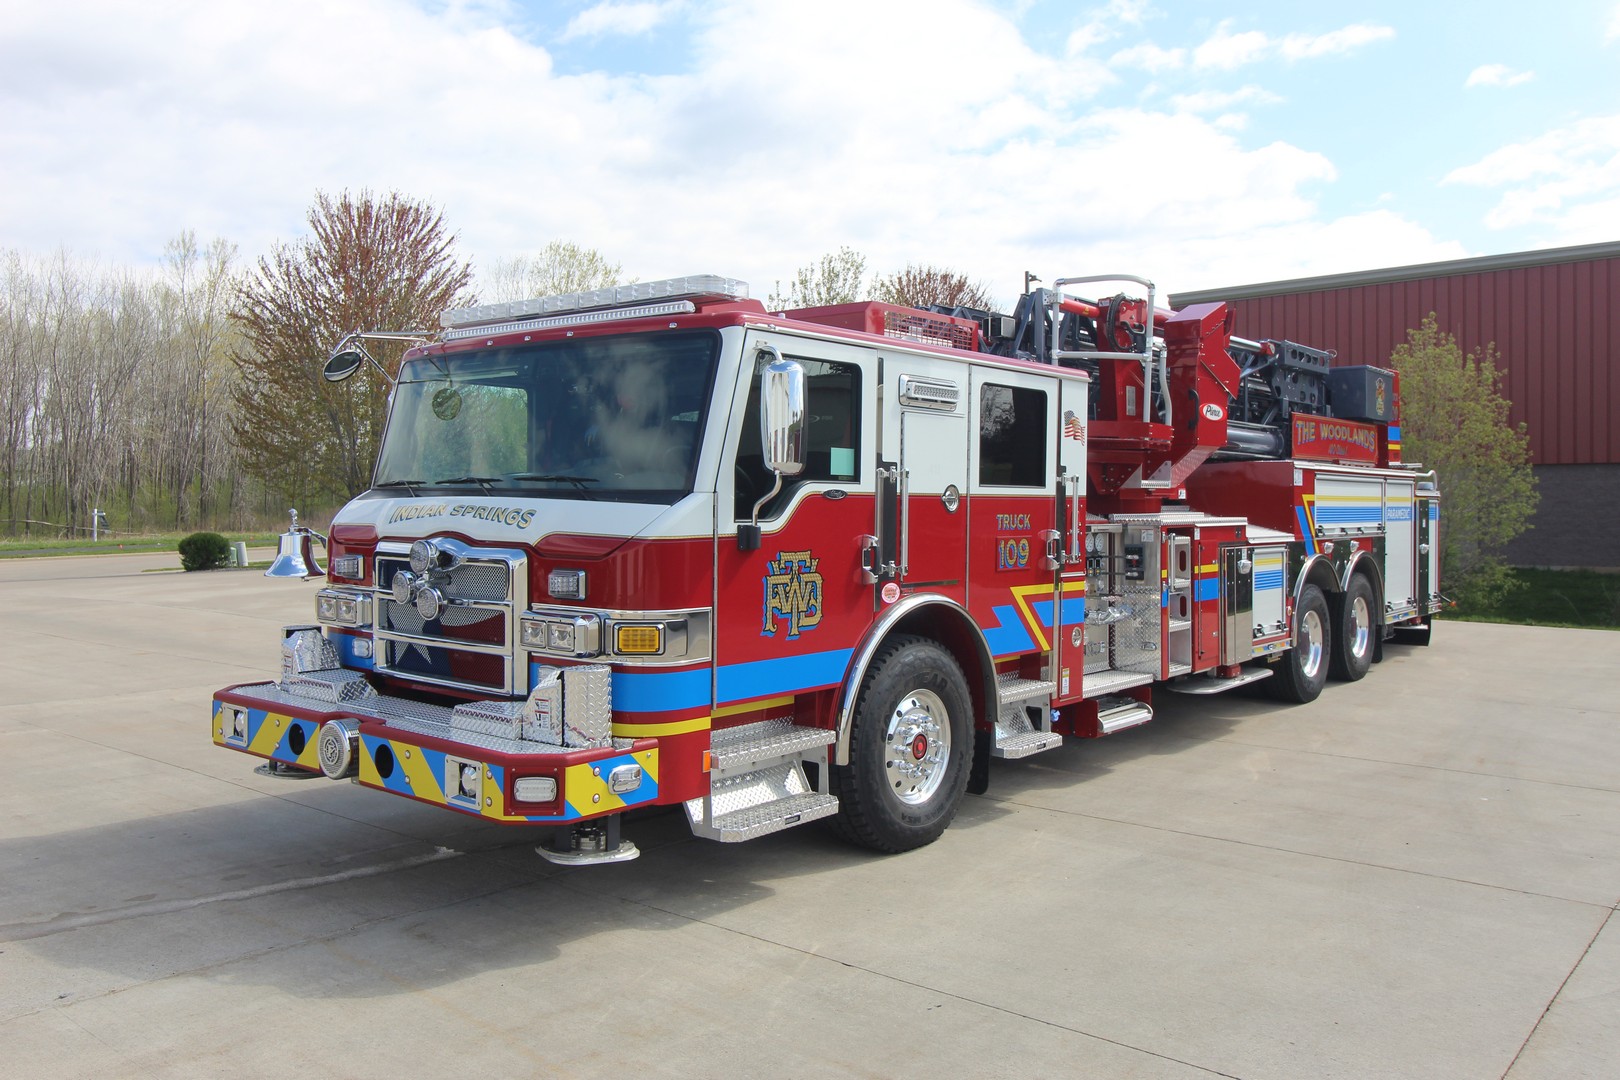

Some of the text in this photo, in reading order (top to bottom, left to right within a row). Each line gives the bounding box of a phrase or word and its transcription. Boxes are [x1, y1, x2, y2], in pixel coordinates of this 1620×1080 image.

[1296, 420, 1316, 445] THE
[1320, 422, 1376, 453] WOODLANDS
[388, 503, 537, 530] INDIAN SPRINGS
[996, 513, 1031, 531] TRUCK
[999, 538, 1030, 569] 109
